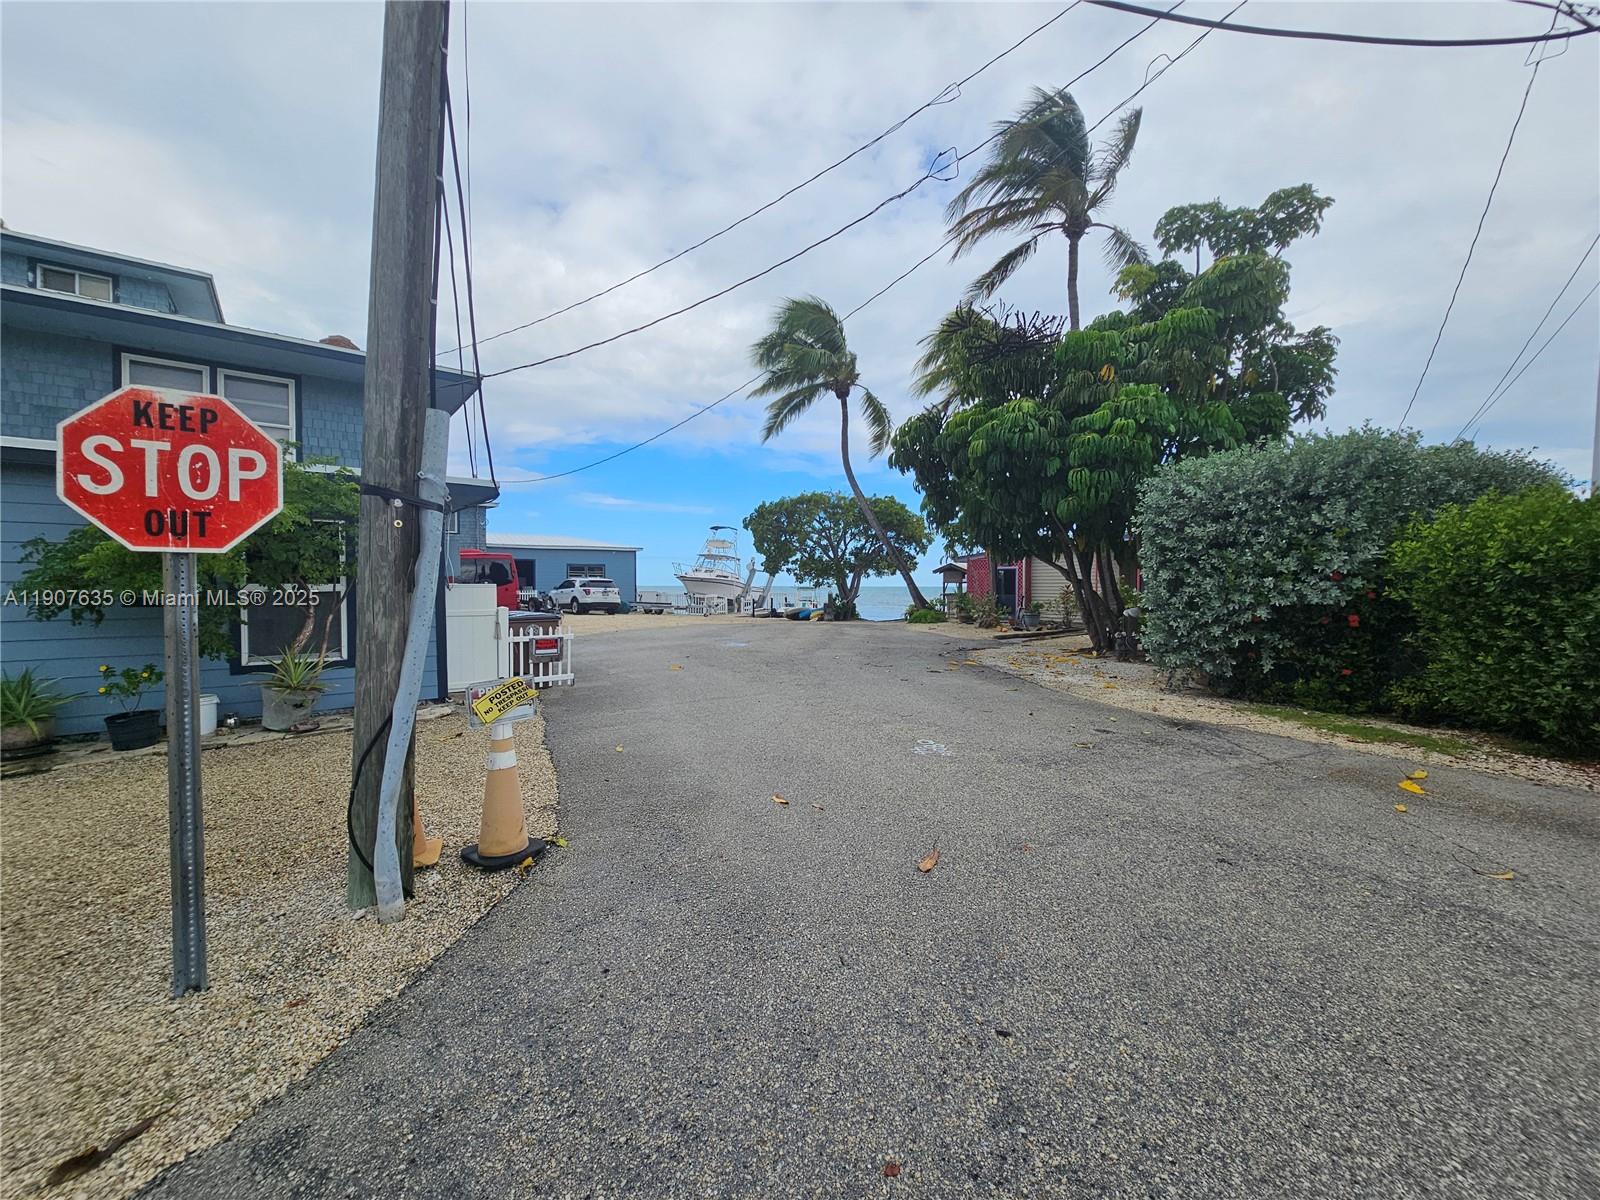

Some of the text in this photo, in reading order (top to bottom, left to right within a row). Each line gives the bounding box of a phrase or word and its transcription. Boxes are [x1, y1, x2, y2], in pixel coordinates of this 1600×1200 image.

[133, 400, 218, 434] KEEP
[77, 434, 267, 502] STOP
[144, 509, 212, 538] OUT
[488, 680, 524, 704] POSTED
[497, 699, 515, 713] KEEP
[516, 691, 529, 702] OUT
[483, 706, 494, 716] NO
